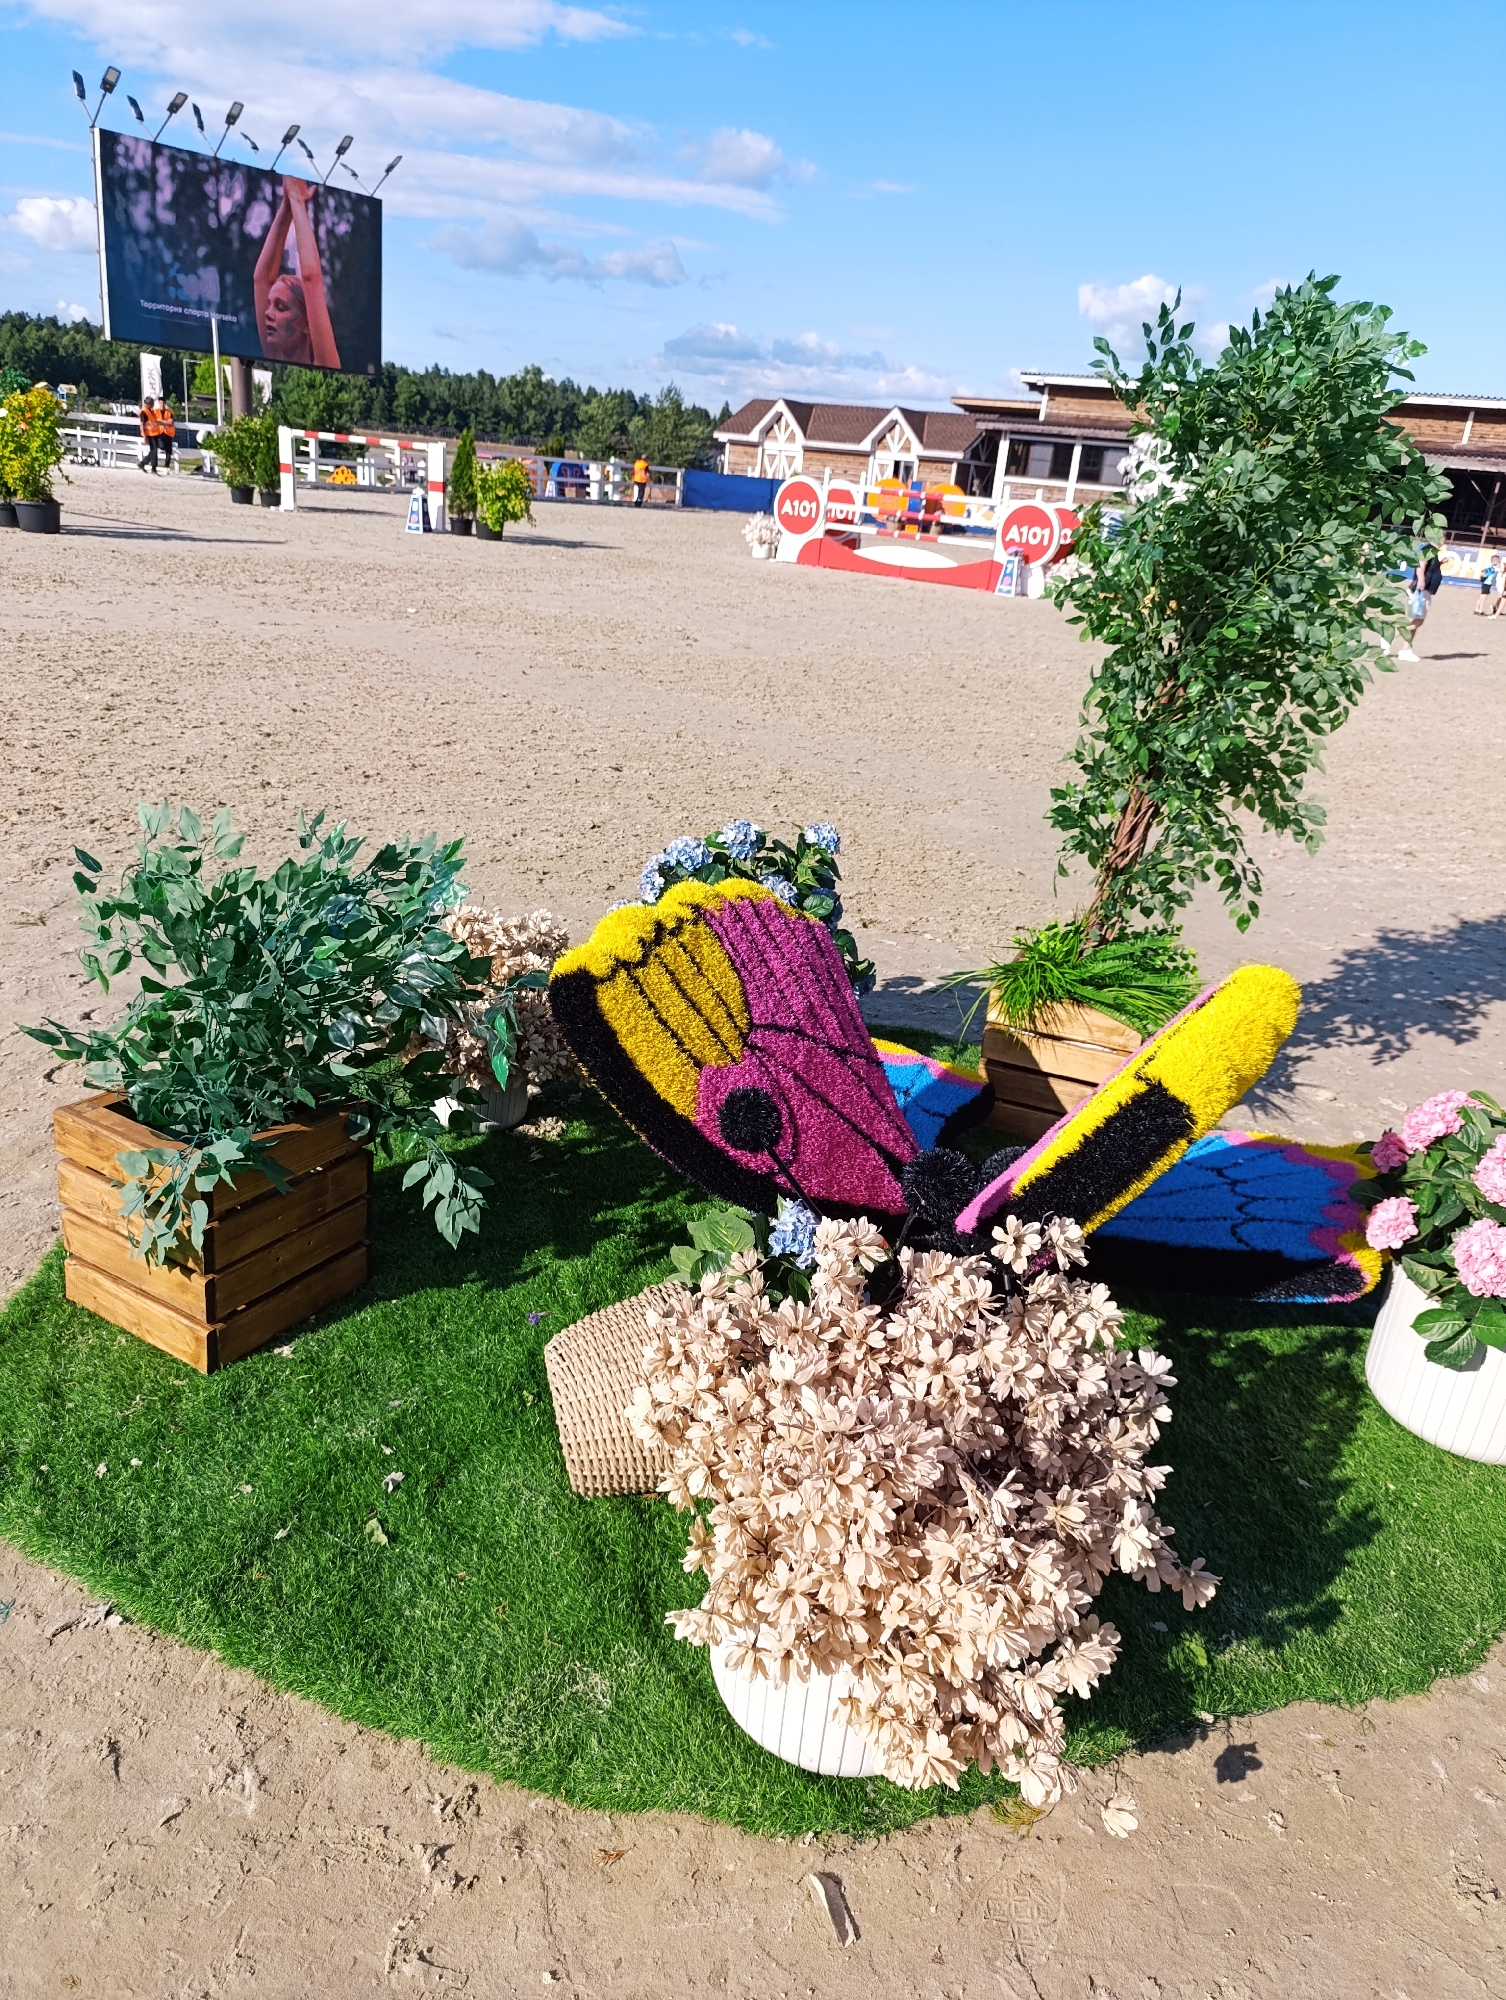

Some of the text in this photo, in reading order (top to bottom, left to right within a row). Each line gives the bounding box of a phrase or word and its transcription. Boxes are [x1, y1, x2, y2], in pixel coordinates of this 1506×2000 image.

[140, 299, 182, 314] Территория
[184, 308, 209, 318] спорта
[781, 499, 817, 519] A101
[1005, 524, 1051, 546] A101
